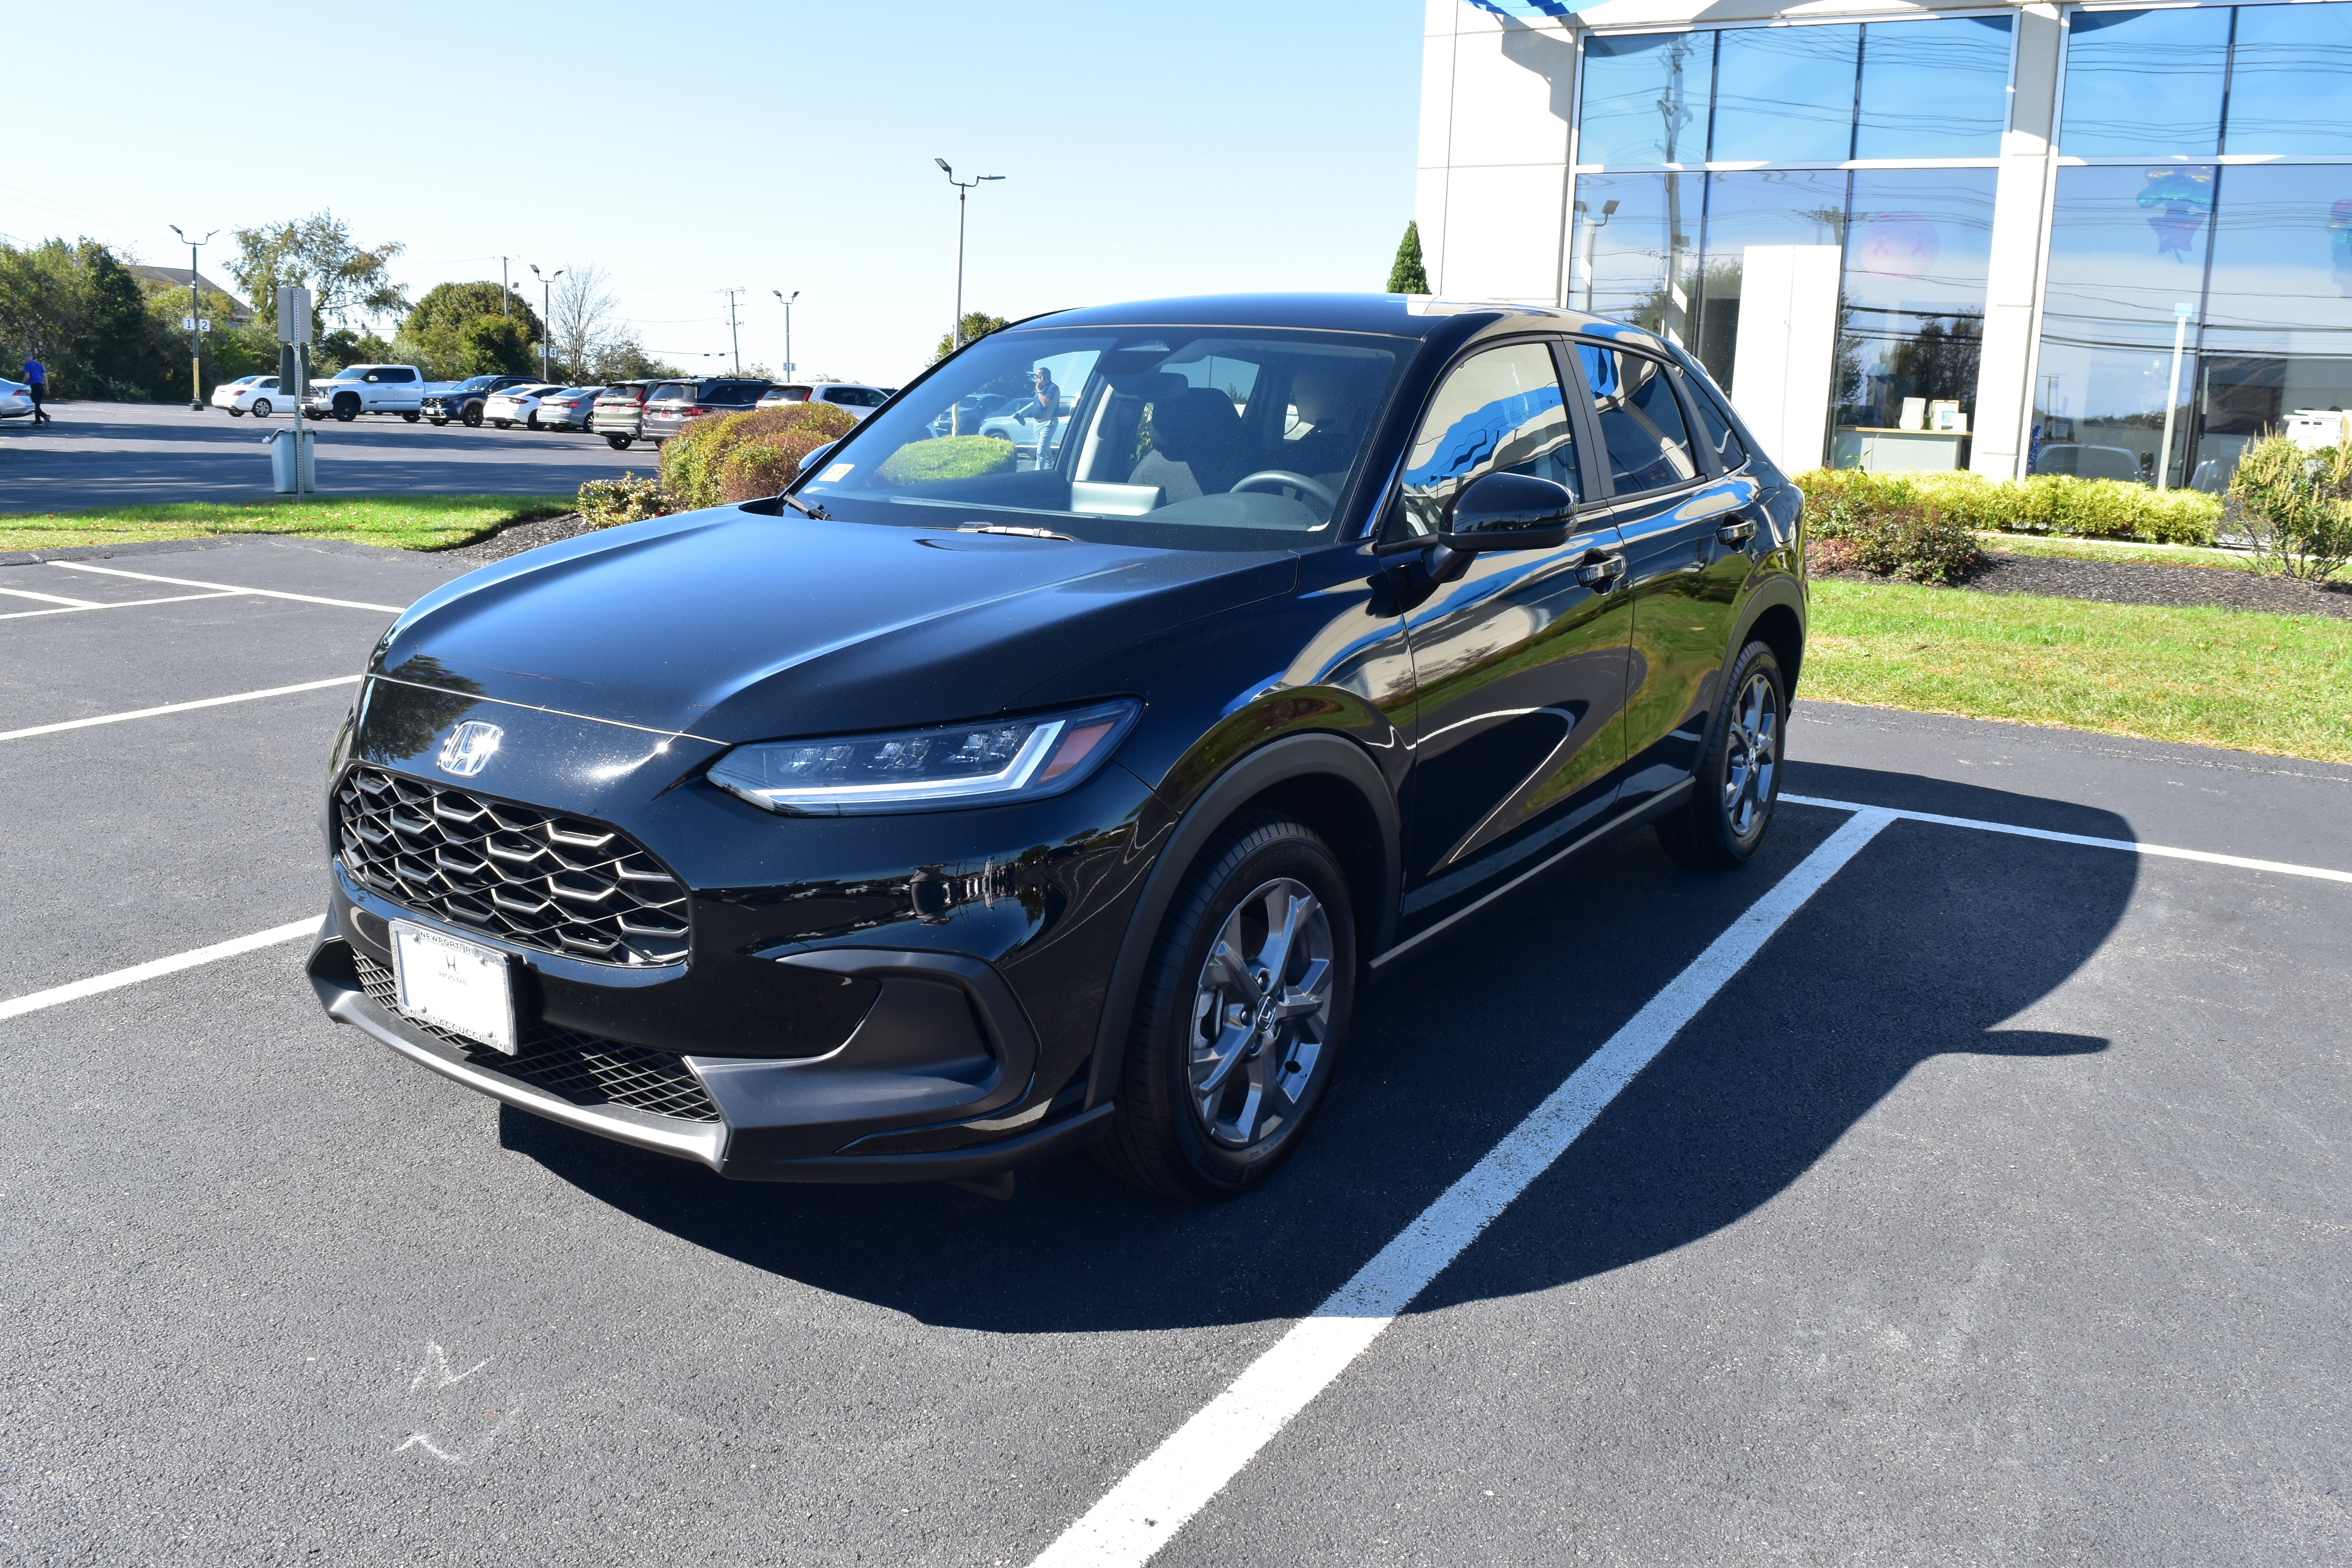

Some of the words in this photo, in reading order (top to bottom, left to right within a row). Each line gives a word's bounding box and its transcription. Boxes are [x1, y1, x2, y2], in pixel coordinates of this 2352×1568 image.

[187, 319, 192, 329] 1
[202, 321, 208, 330] 2
[466, 946, 474, 954] RI
[439, 971, 467, 985] HONDA
[433, 1016, 481, 1041] SACCUCCI
